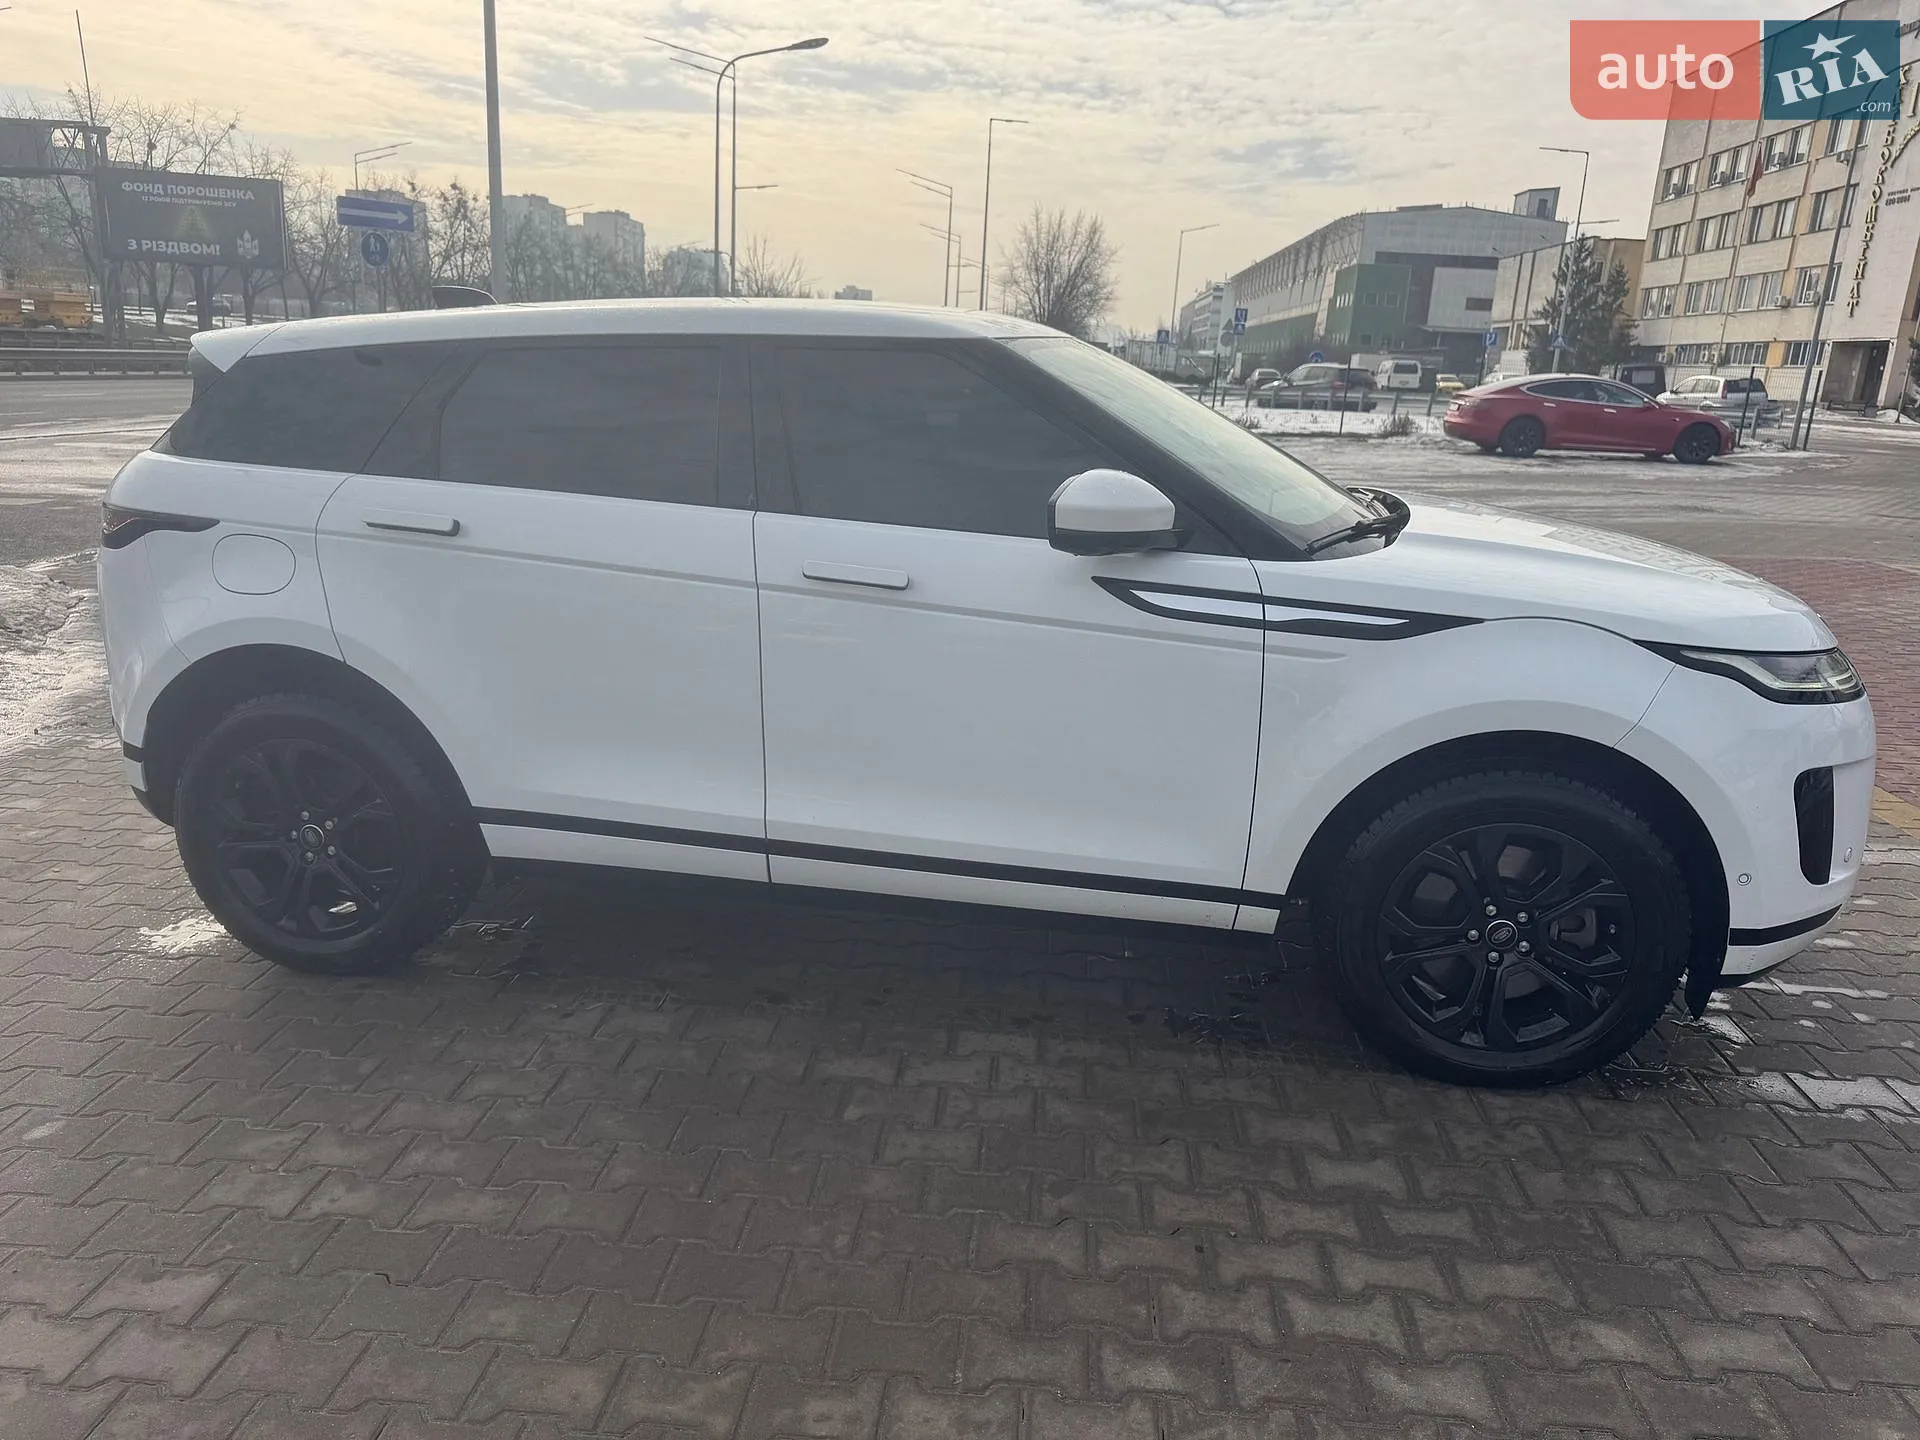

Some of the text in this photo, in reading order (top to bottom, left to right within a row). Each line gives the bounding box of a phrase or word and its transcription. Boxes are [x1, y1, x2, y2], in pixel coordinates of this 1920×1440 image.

[121, 181, 255, 200] ФОНД ПОРОШЕНКА
[127, 239, 221, 255] З РІЗДВОМ!
